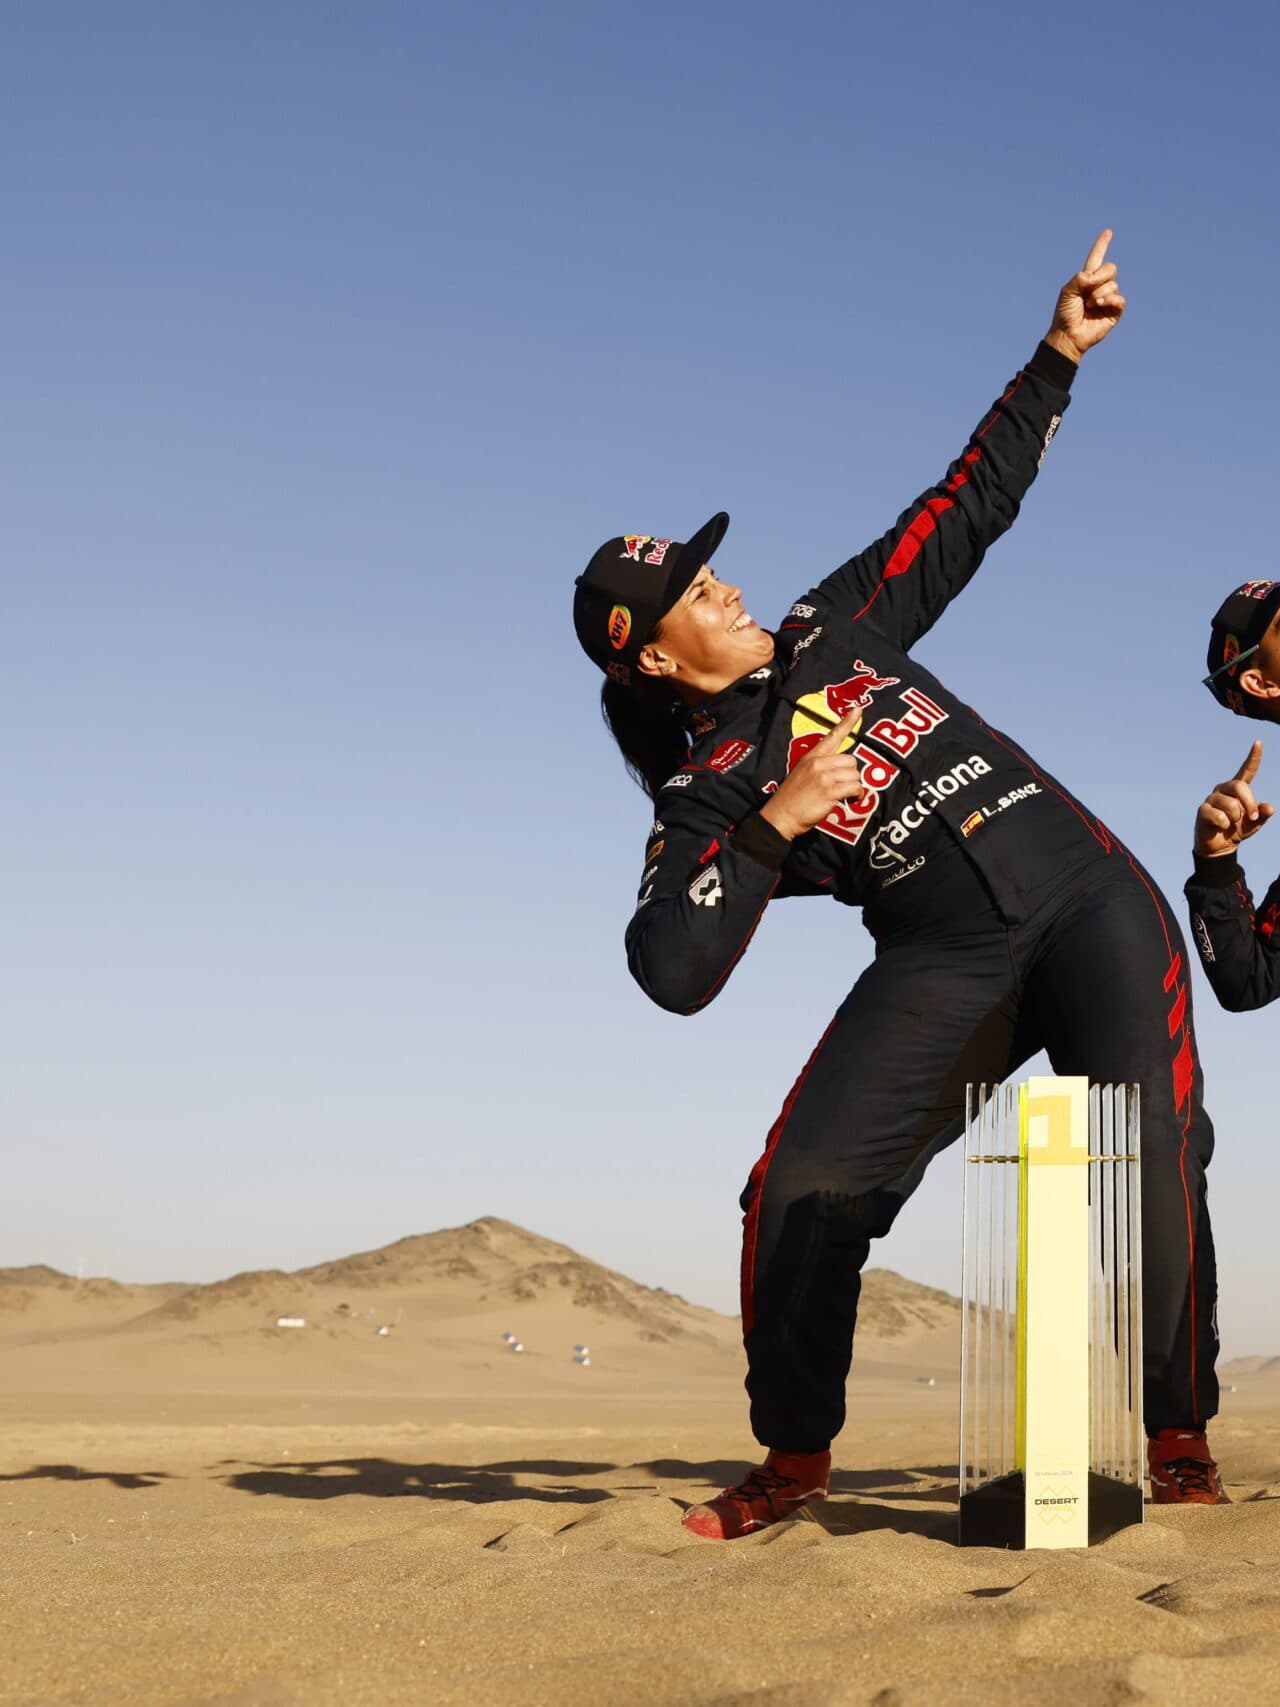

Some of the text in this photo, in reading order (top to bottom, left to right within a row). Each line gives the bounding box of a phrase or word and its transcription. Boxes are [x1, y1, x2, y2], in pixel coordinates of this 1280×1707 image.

[815, 687, 949, 846] Red Bull
[889, 755, 993, 845] acciona
[981, 782, 1043, 818] L.SANZ
[1027, 1095, 1088, 1166] 1
[1034, 1497, 1079, 1506] DESERT
